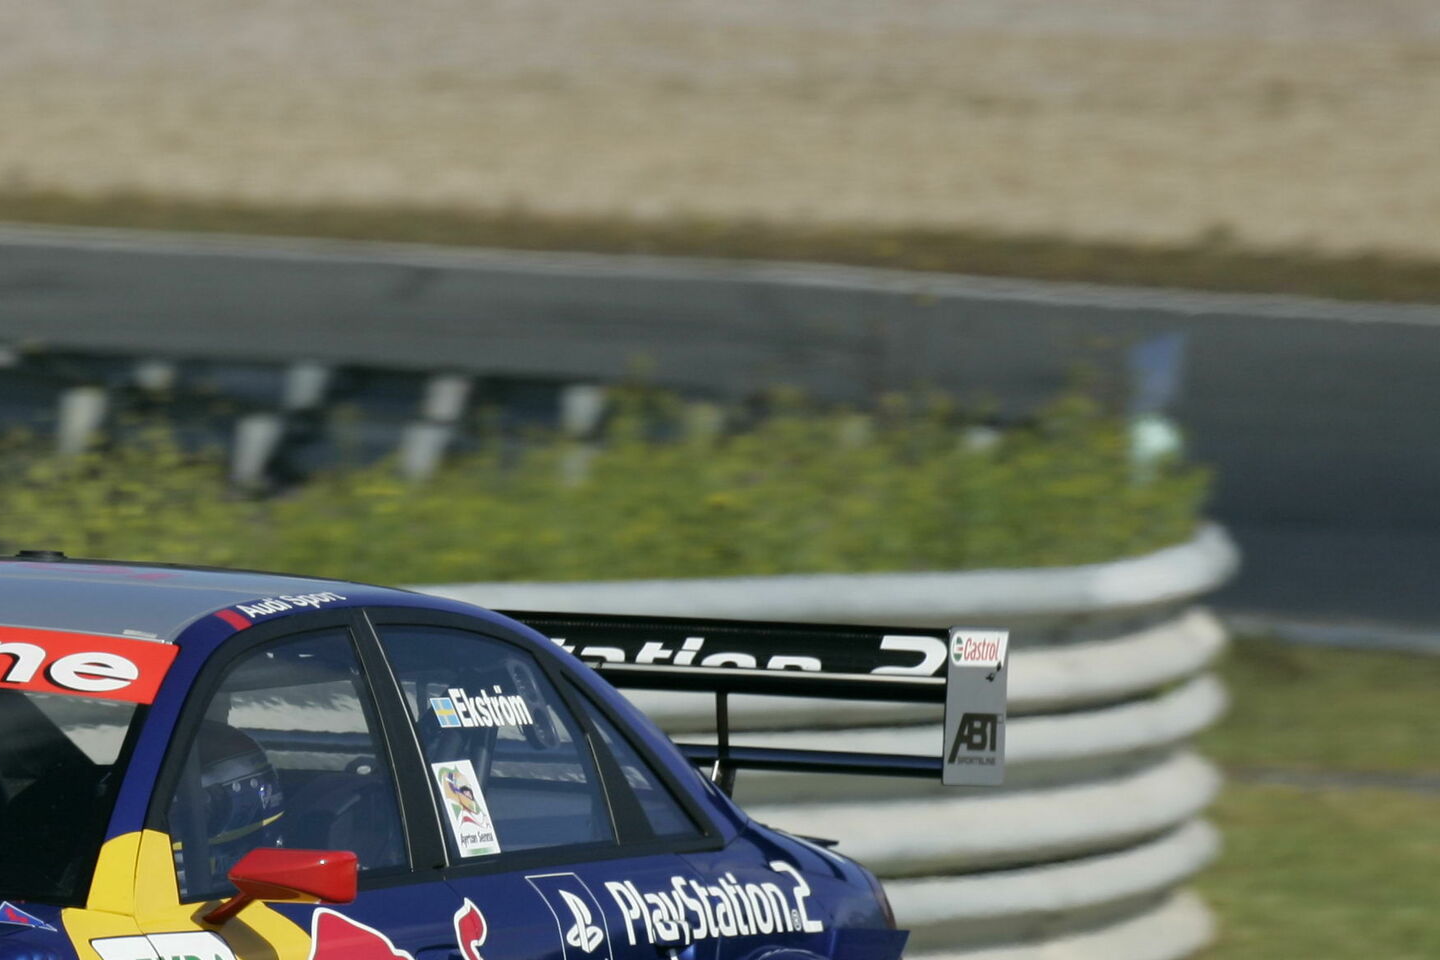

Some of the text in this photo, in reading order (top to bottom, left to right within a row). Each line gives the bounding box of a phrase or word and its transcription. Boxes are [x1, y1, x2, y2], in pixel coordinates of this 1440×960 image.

[235, 591, 346, 618] Audi Sport
[870, 635, 948, 676] 2
[963, 637, 1001, 662] Castrol
[448, 685, 533, 728] Ekström
[947, 713, 998, 765] ABT
